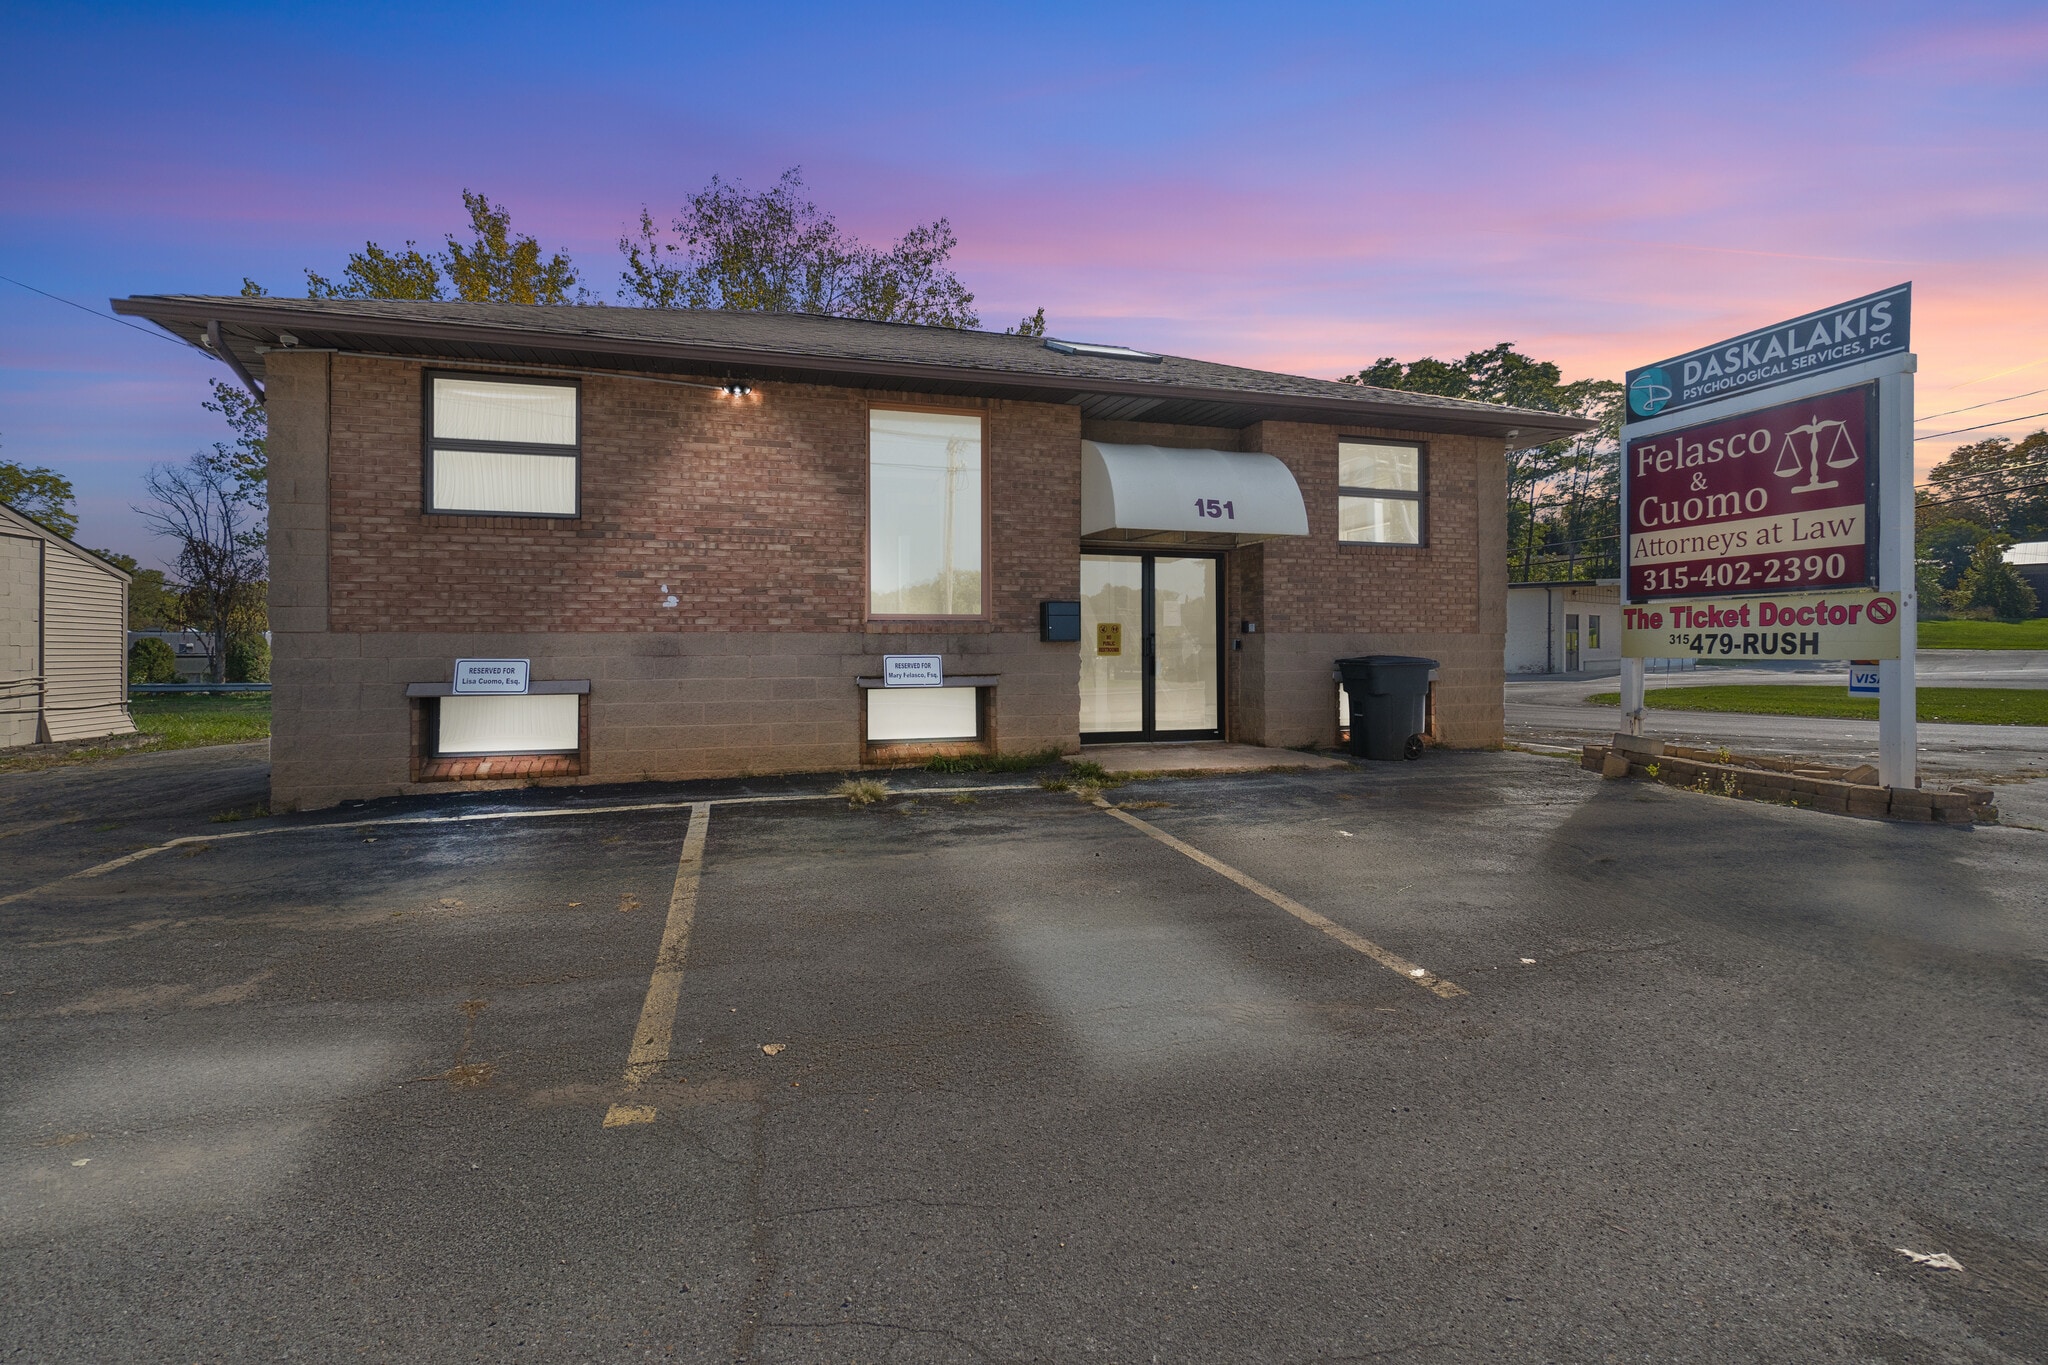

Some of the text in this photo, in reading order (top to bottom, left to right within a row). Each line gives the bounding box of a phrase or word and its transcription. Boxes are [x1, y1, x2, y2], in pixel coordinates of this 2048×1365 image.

[1684, 301, 1892, 386] DASKALAKIS
[1684, 333, 1892, 400] PSYCHOLOGICAL SERVICES, PC
[1637, 428, 1772, 477] Felasco
[1690, 472, 1708, 491] &
[1194, 498, 1234, 519] 151
[1638, 487, 1768, 527] Cuomo
[1634, 517, 1856, 559] Attorneys at Law
[1643, 554, 1845, 591] 315-402-2390
[1623, 600, 1863, 630] The Ticket Doctor
[1669, 632, 1819, 655] 315 479-RUSH
